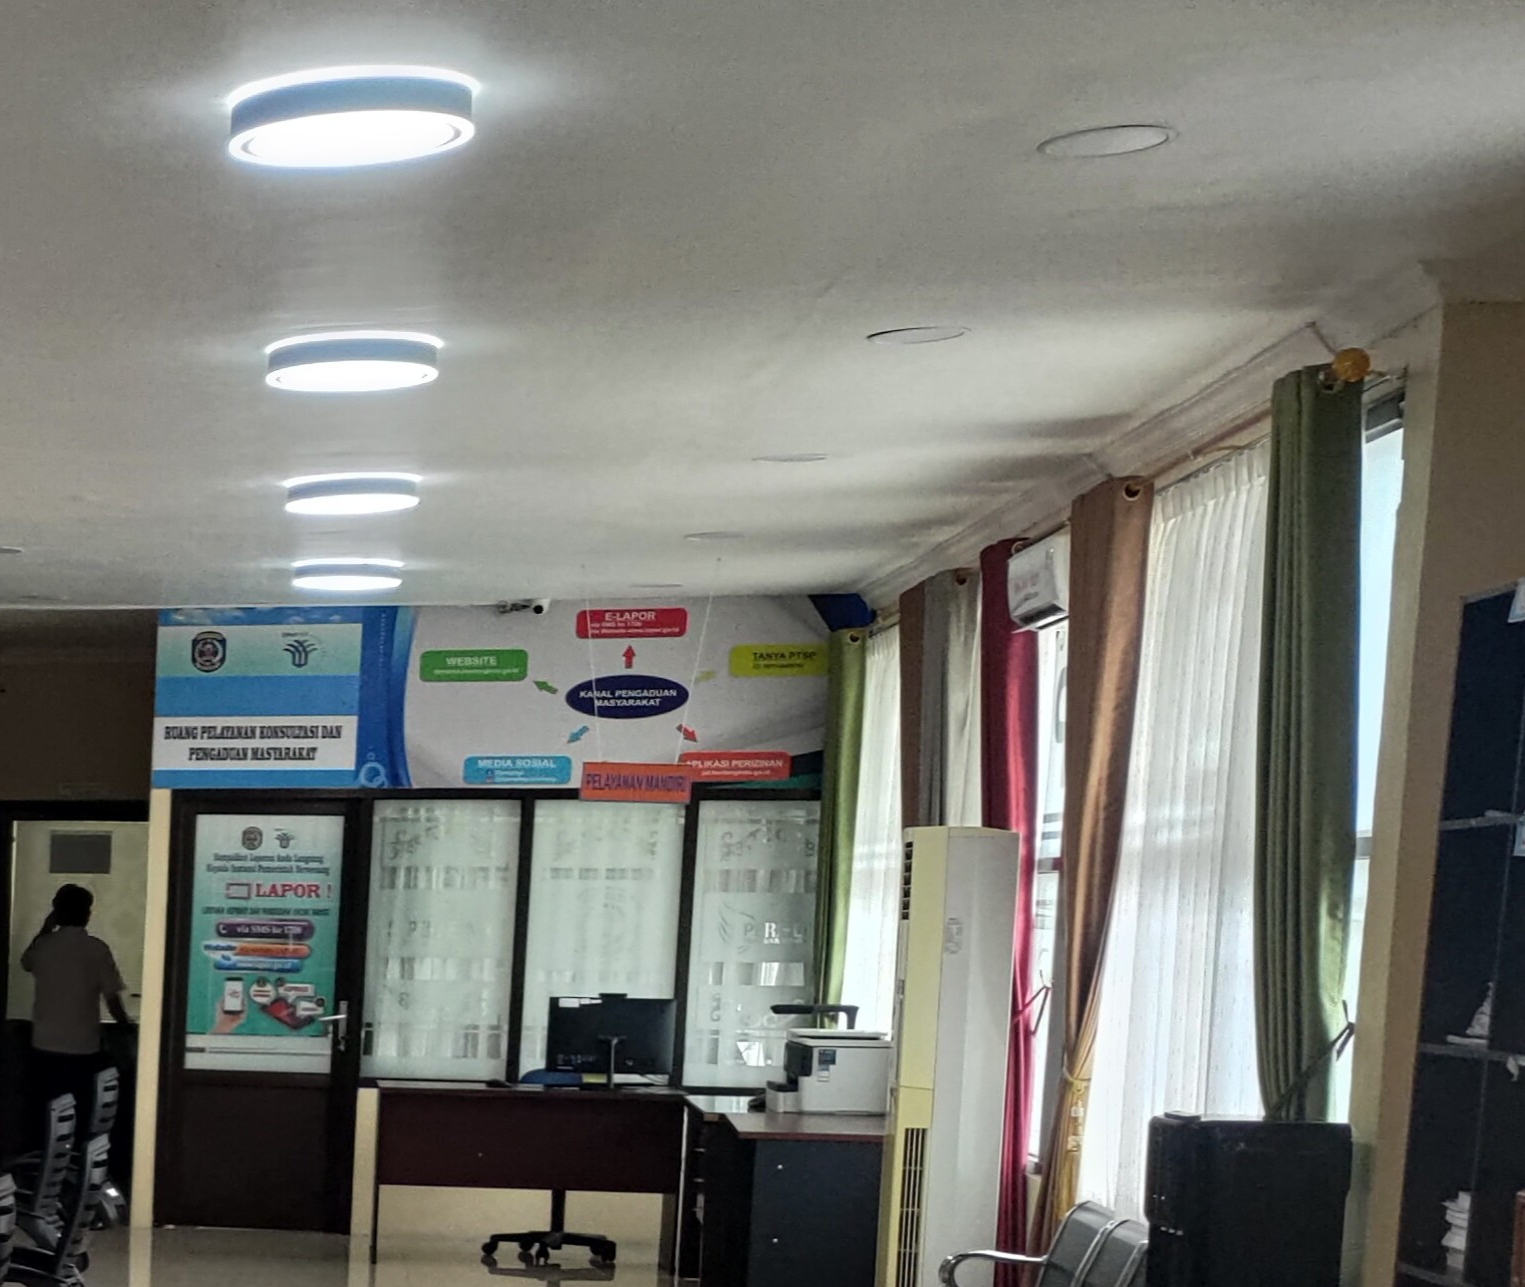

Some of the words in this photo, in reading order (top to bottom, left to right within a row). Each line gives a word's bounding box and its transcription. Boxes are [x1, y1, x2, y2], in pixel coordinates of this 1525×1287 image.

[605, 611, 656, 621] E-LAPOR
[446, 656, 497, 666] WEBSITE
[753, 652, 786, 660] TANYA
[579, 690, 612, 698] KANAL
[615, 689, 677, 698] PENGADUAN
[596, 699, 661, 707] MASYARAKAT
[164, 726, 198, 739] RUANG
[200, 726, 257, 739] PELAYANAN
[259, 726, 319, 739] KONSULTASI
[321, 725, 342, 739] DAN
[188, 747, 248, 760] PENGADUAN
[250, 747, 318, 760] MASYARAKAT
[478, 759, 513, 767] MEDIA
[516, 759, 556, 768] SOSIAL
[586, 774, 642, 791] PELAYANAN
[255, 883, 321, 898] LAPOR
